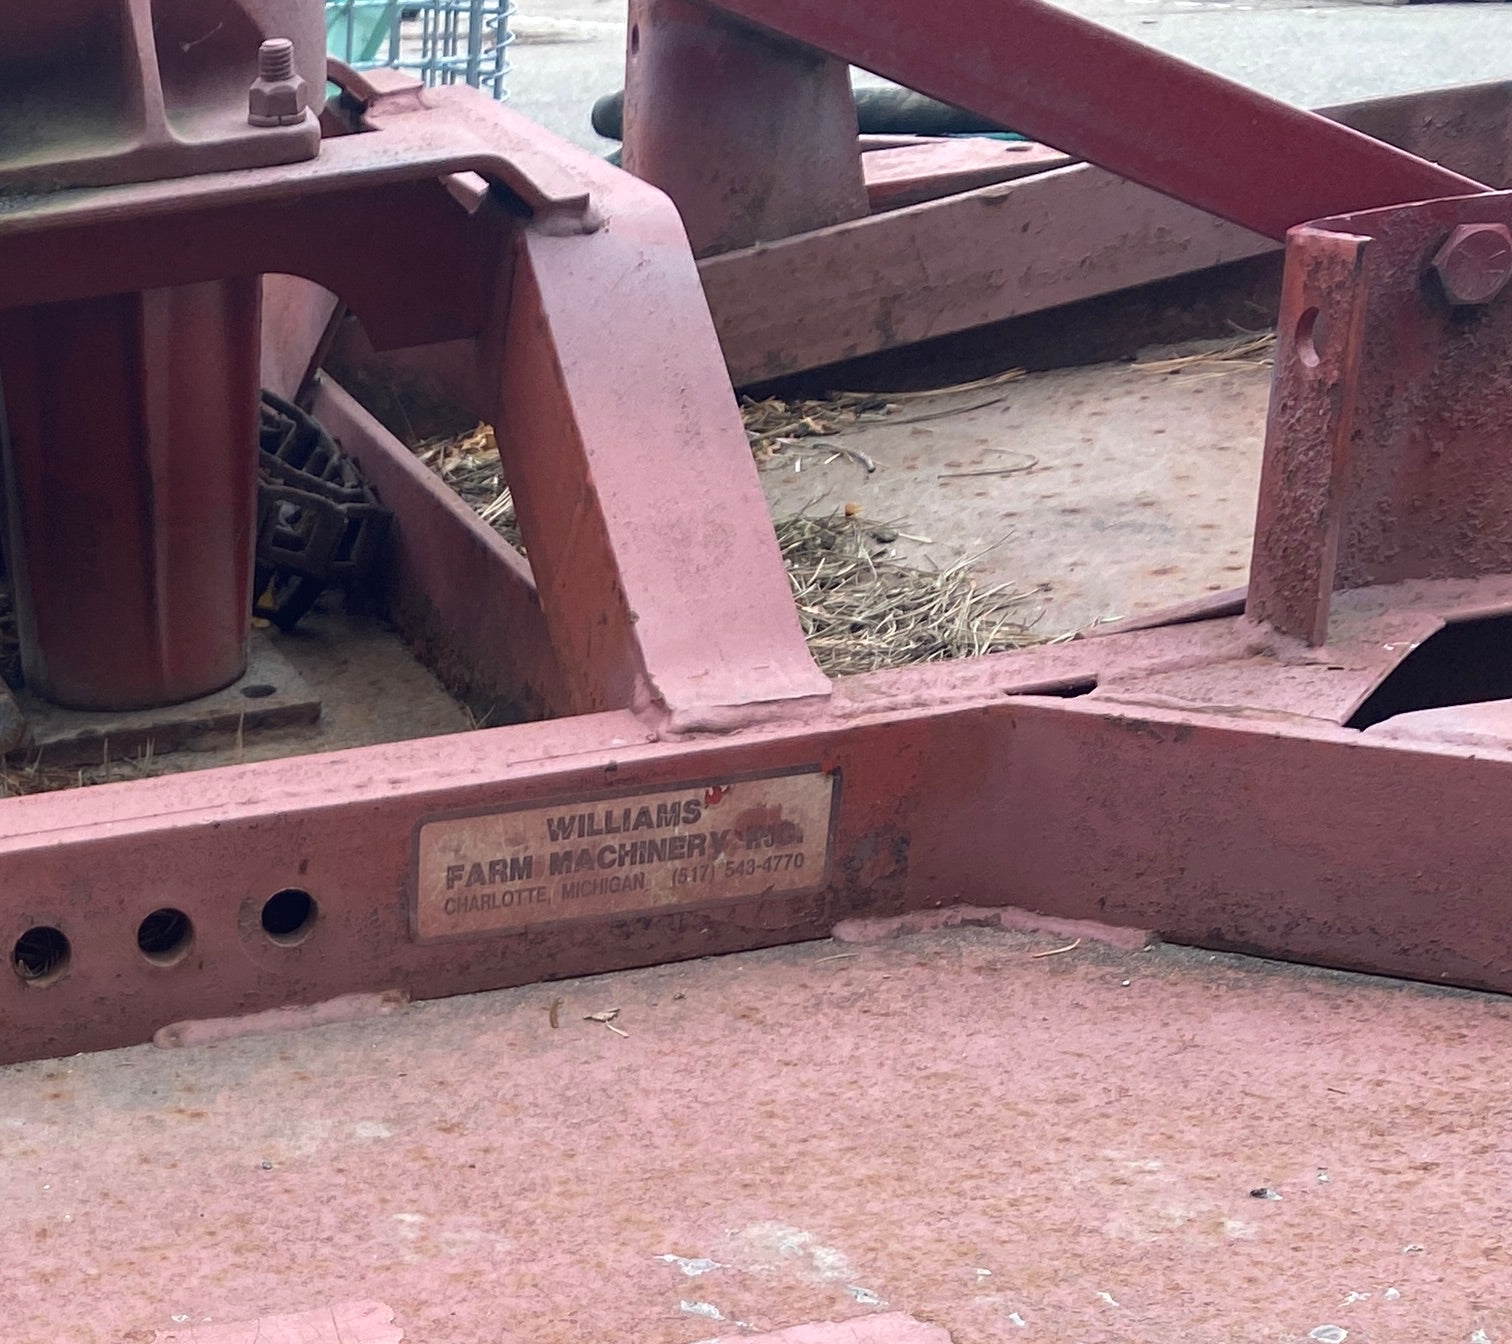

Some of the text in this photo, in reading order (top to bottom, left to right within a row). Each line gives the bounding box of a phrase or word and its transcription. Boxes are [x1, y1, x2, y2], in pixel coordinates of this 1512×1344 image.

[546, 798, 702, 843] WILLIAMS
[445, 855, 534, 891] FARM
[549, 828, 730, 877] MACHINERY
[561, 871, 646, 901] MICHIGAN
[672, 863, 715, 888] (517)
[724, 851, 805, 878] 543-4770
